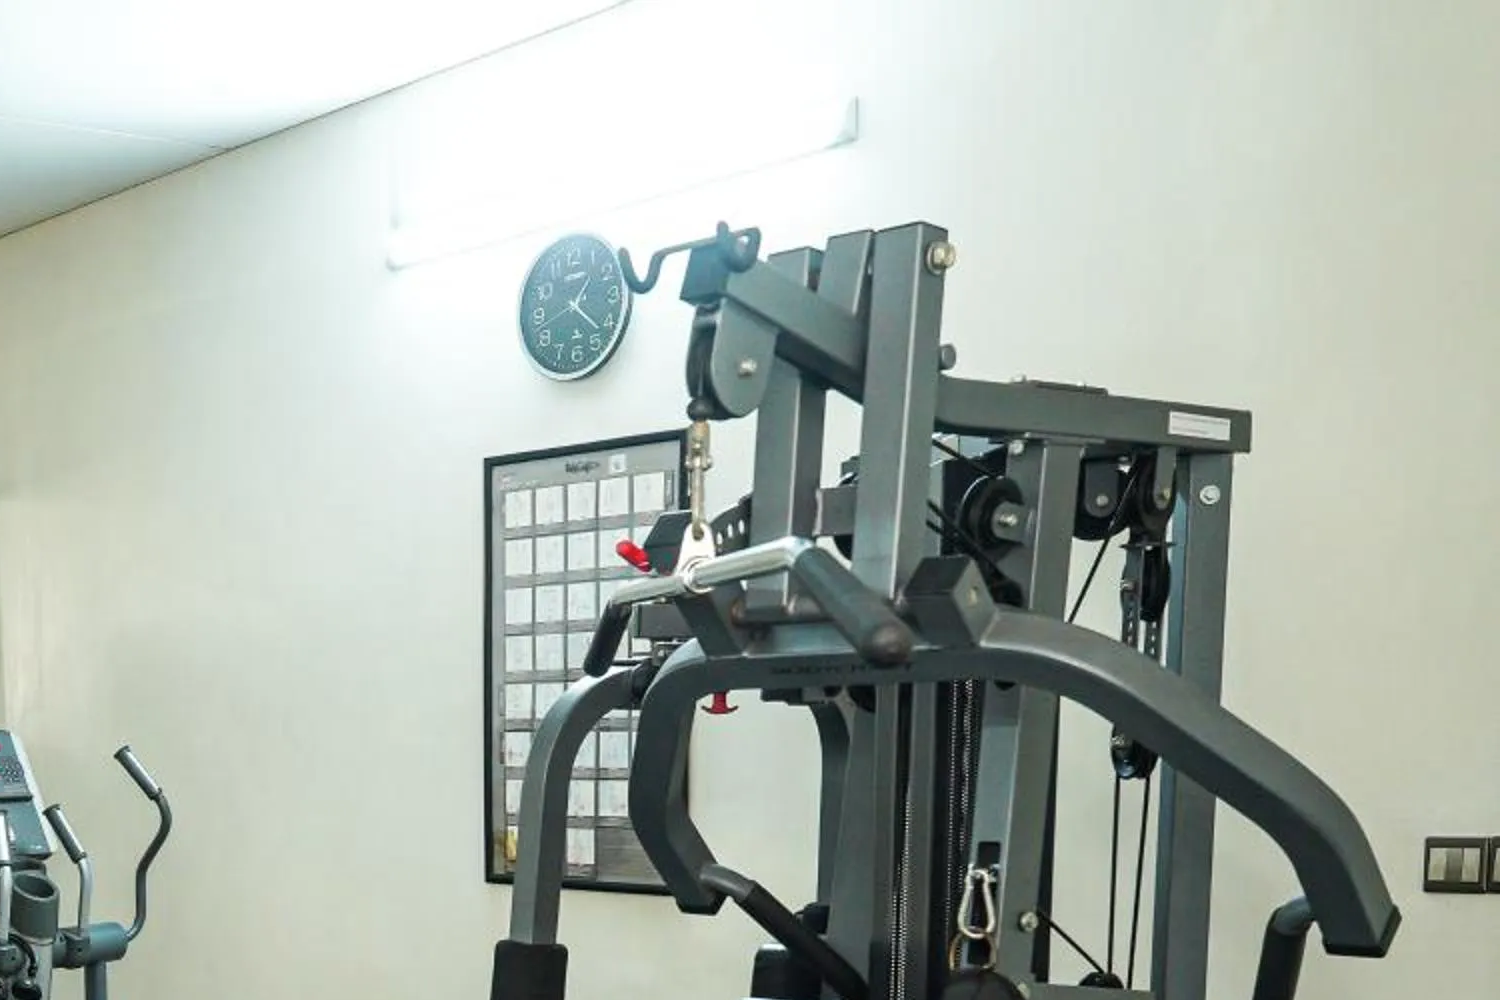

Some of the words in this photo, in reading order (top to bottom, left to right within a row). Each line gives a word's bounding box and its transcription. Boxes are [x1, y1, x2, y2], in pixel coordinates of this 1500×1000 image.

[606, 285, 619, 304] 3
[603, 312, 615, 328] 4
[589, 333, 601, 351] 5
[571, 345, 583, 362] 6
